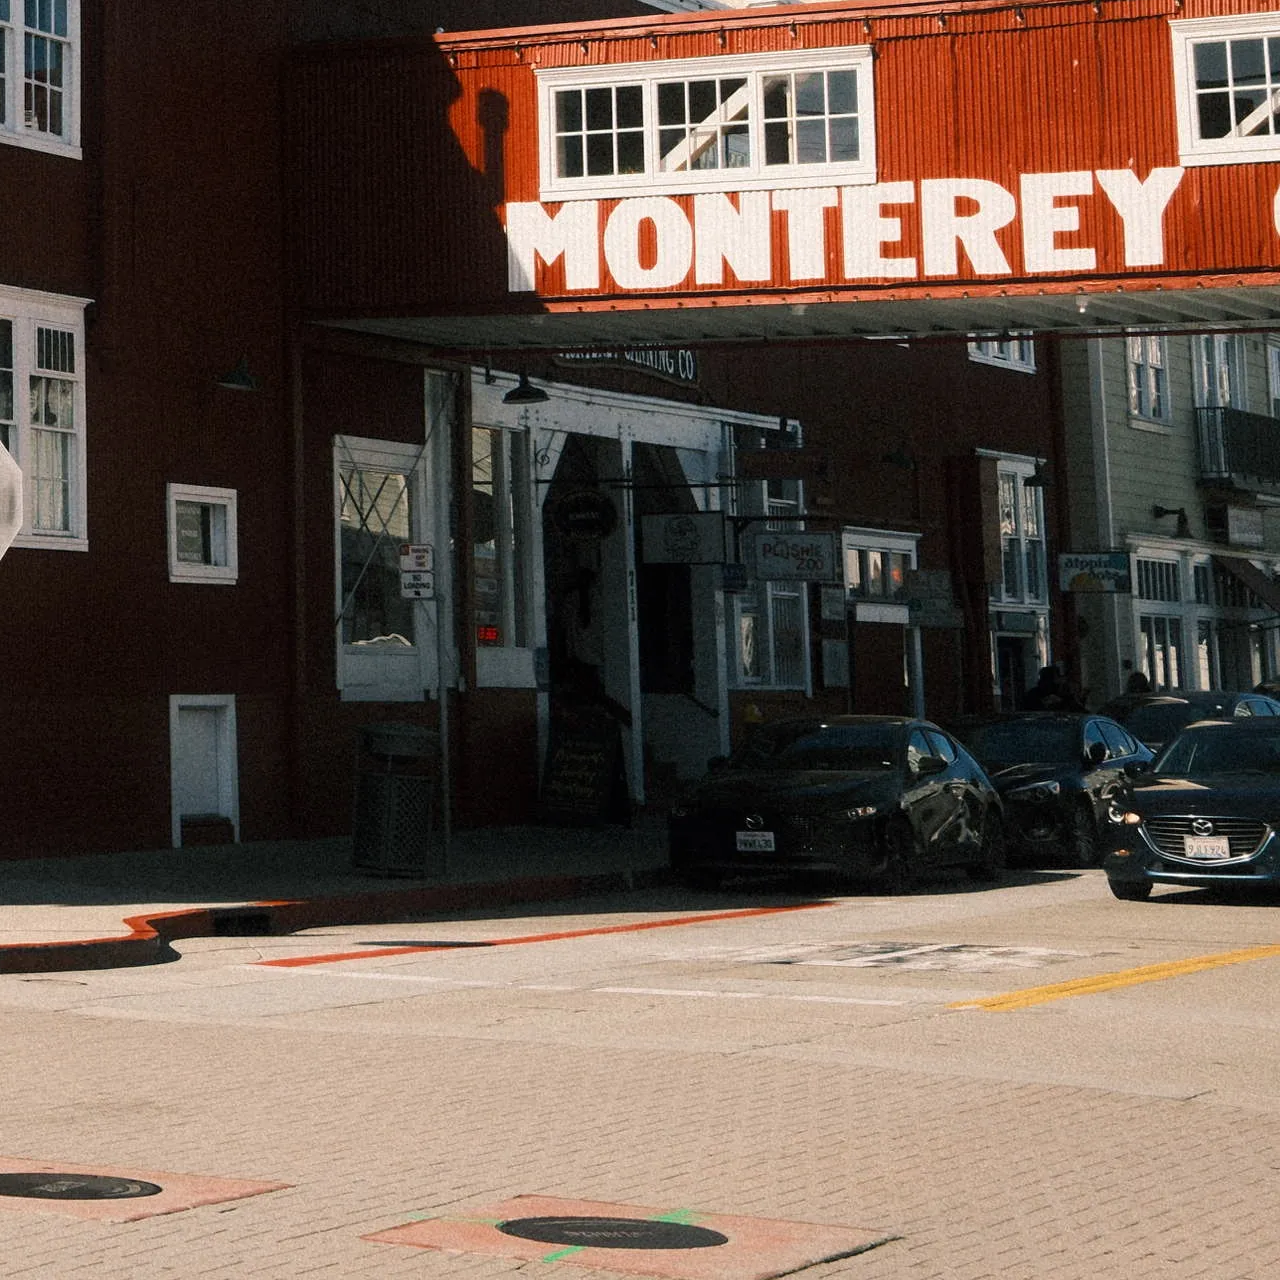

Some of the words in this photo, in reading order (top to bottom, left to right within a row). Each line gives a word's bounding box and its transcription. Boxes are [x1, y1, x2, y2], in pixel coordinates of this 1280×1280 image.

[506, 166, 1185, 293] MONTEREY
[678, 349, 694, 380] CO
[797, 556, 823, 571] ZOO
